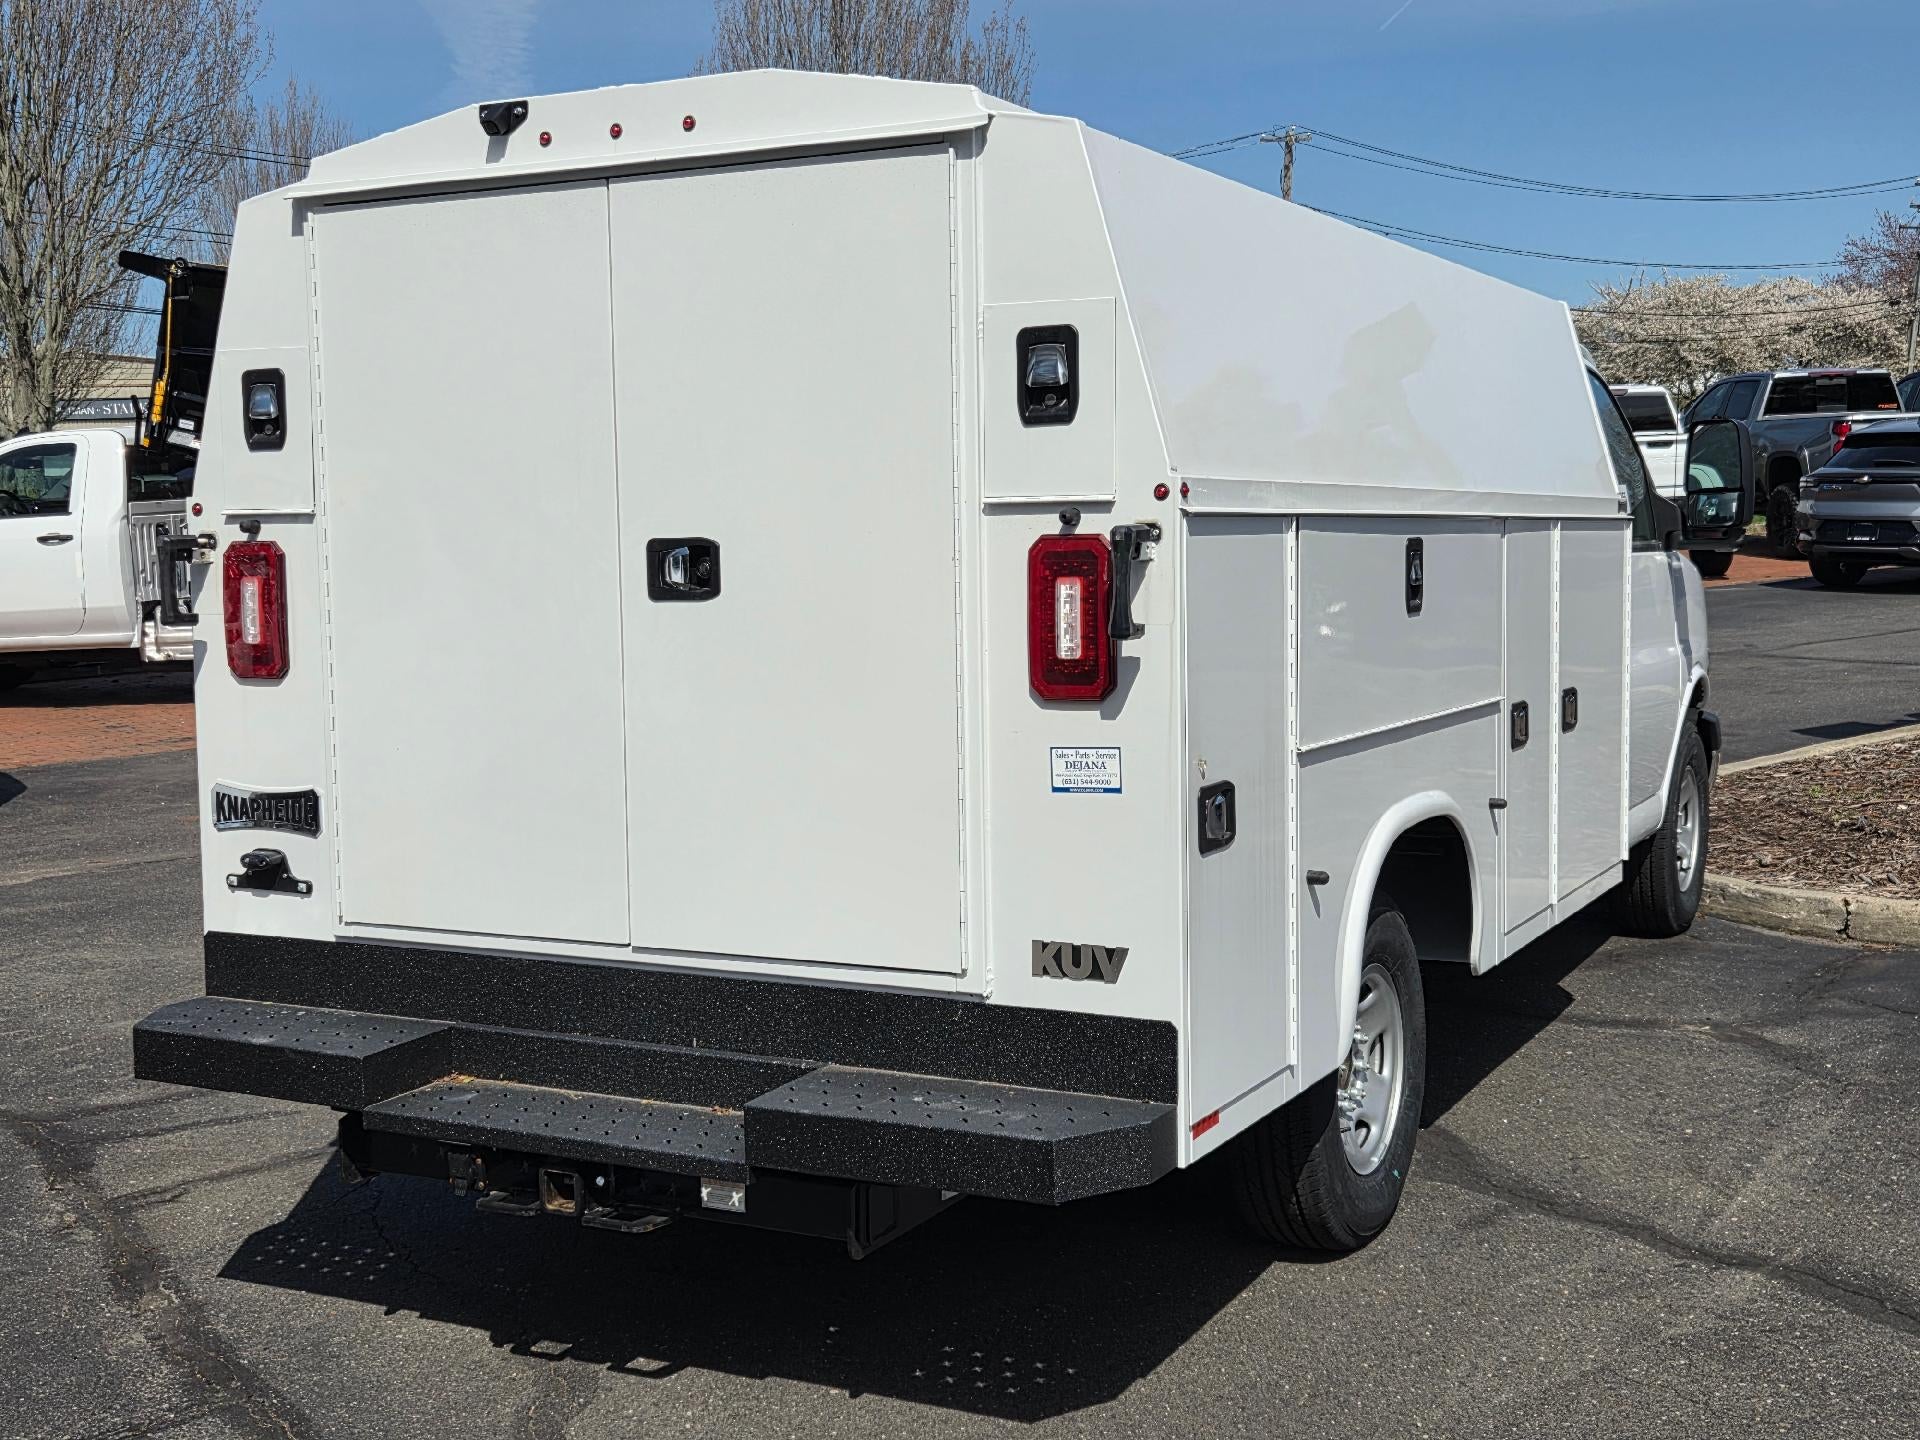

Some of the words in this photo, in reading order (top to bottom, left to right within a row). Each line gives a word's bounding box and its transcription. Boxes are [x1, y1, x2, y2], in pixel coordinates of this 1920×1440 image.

[1055, 749, 1070, 759] Sales
[1075, 749, 1091, 759] Parts
[1095, 749, 1117, 759] Service
[1064, 760, 1107, 770] DEJANA
[1061, 778, 1079, 786] (631)
[215, 791, 316, 827] KNAPHEIDE
[1031, 940, 1130, 984] KUV
